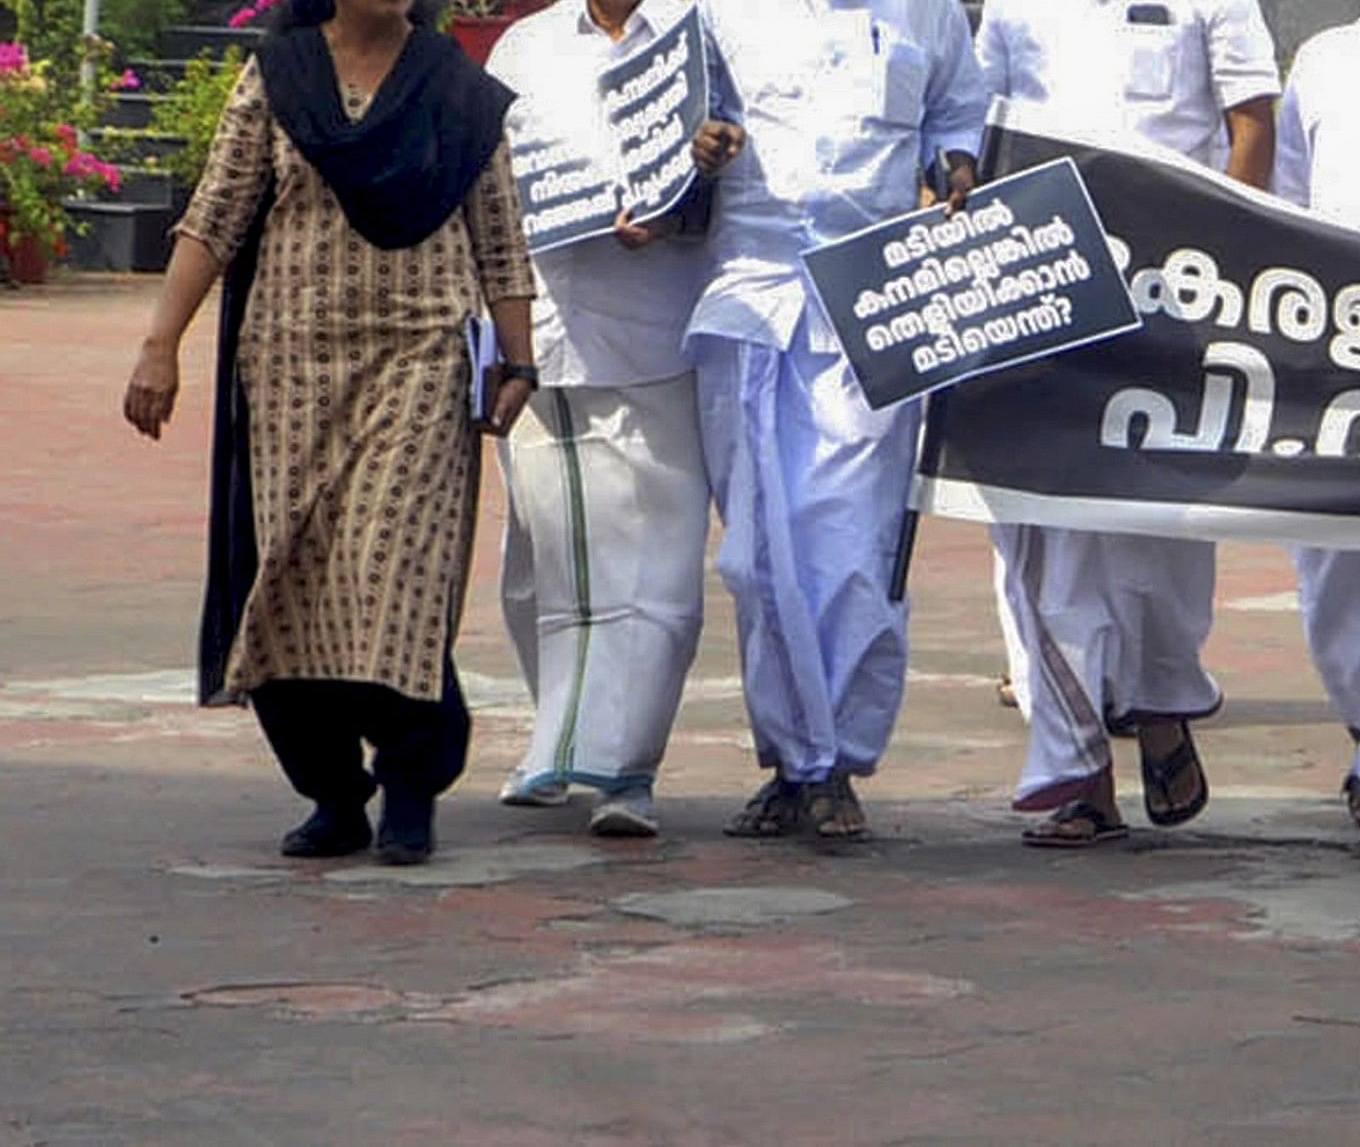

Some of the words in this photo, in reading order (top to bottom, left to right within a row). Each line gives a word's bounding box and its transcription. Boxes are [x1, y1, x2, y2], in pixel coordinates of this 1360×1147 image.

[853, 216, 1074, 319] കനമില്ലെങ്കിൽ
[883, 199, 1013, 267] മടിയിൽ
[866, 251, 1090, 351] തെളിയിക്കാൻ
[912, 295, 1072, 373] മടിയെന്ത്?
